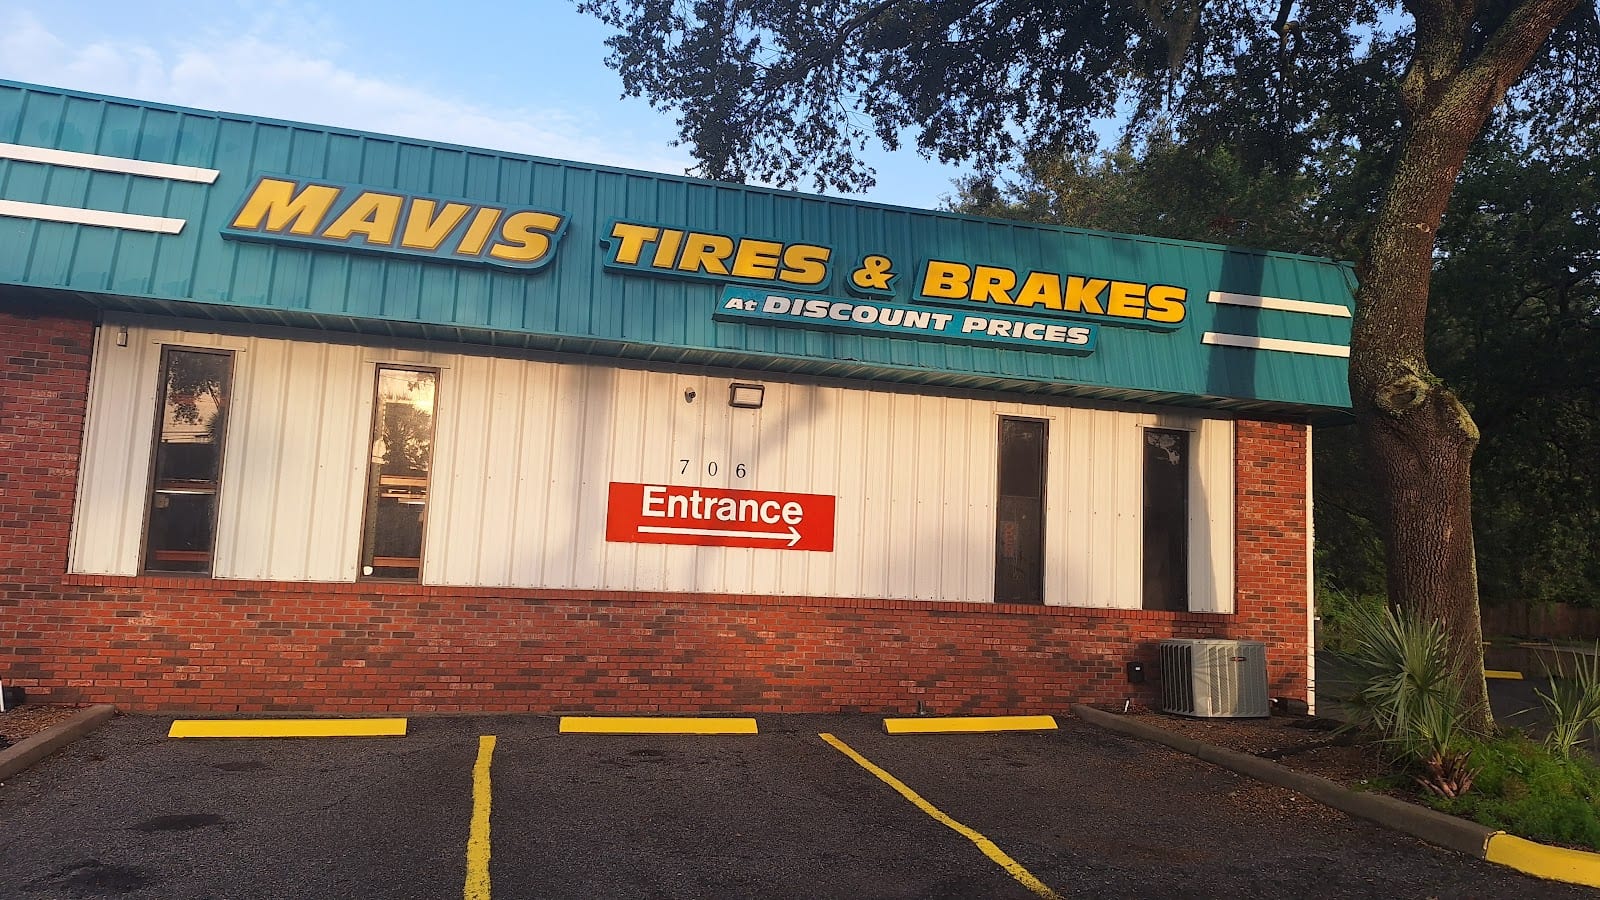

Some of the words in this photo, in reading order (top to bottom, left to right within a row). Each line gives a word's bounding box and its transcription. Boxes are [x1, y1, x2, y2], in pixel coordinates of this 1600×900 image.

[232, 178, 562, 262] MAVIS
[612, 223, 831, 284] TIRES
[853, 255, 895, 290] &
[921, 260, 1187, 324] BRAKES
[725, 297, 758, 311] At
[762, 296, 953, 331] DISCOUNT
[962, 316, 1091, 345] PRICES
[641, 485, 804, 525] Entrance
